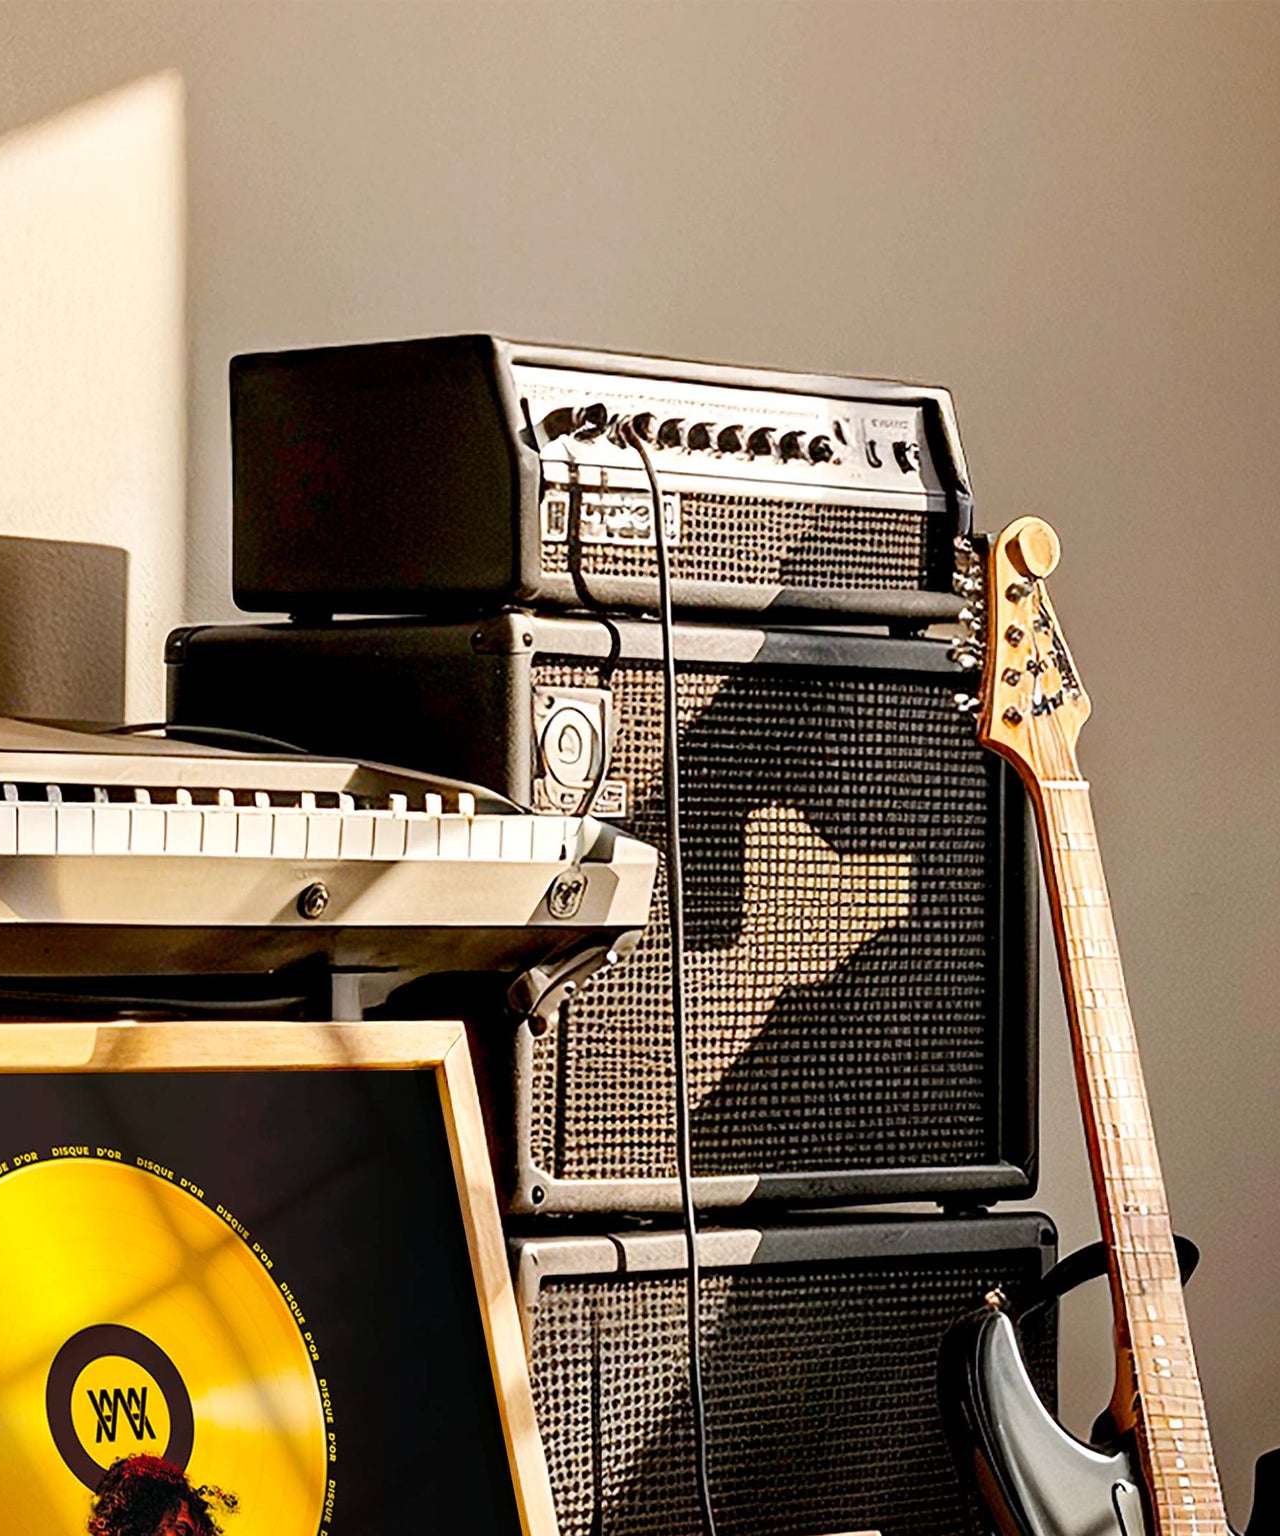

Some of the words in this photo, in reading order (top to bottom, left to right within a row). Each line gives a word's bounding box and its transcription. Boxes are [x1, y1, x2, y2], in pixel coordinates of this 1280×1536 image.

[13, 1151, 38, 1167] D'OR
[51, 1145, 90, 1157] DISQUE
[96, 1147, 122, 1160] D'OR
[136, 1157, 175, 1180] DISQUE
[180, 1177, 205, 1199] D'OR
[215, 1204, 249, 1239] DISQUE
[252, 1242, 274, 1269] D'OR
[279, 1281, 306, 1325] DISQUE
[303, 1331, 320, 1361] D'OR
[319, 1378, 334, 1423] DISQUE
[327, 1432, 337, 1462] D'OR
[323, 1479, 337, 1523] DISQUE
